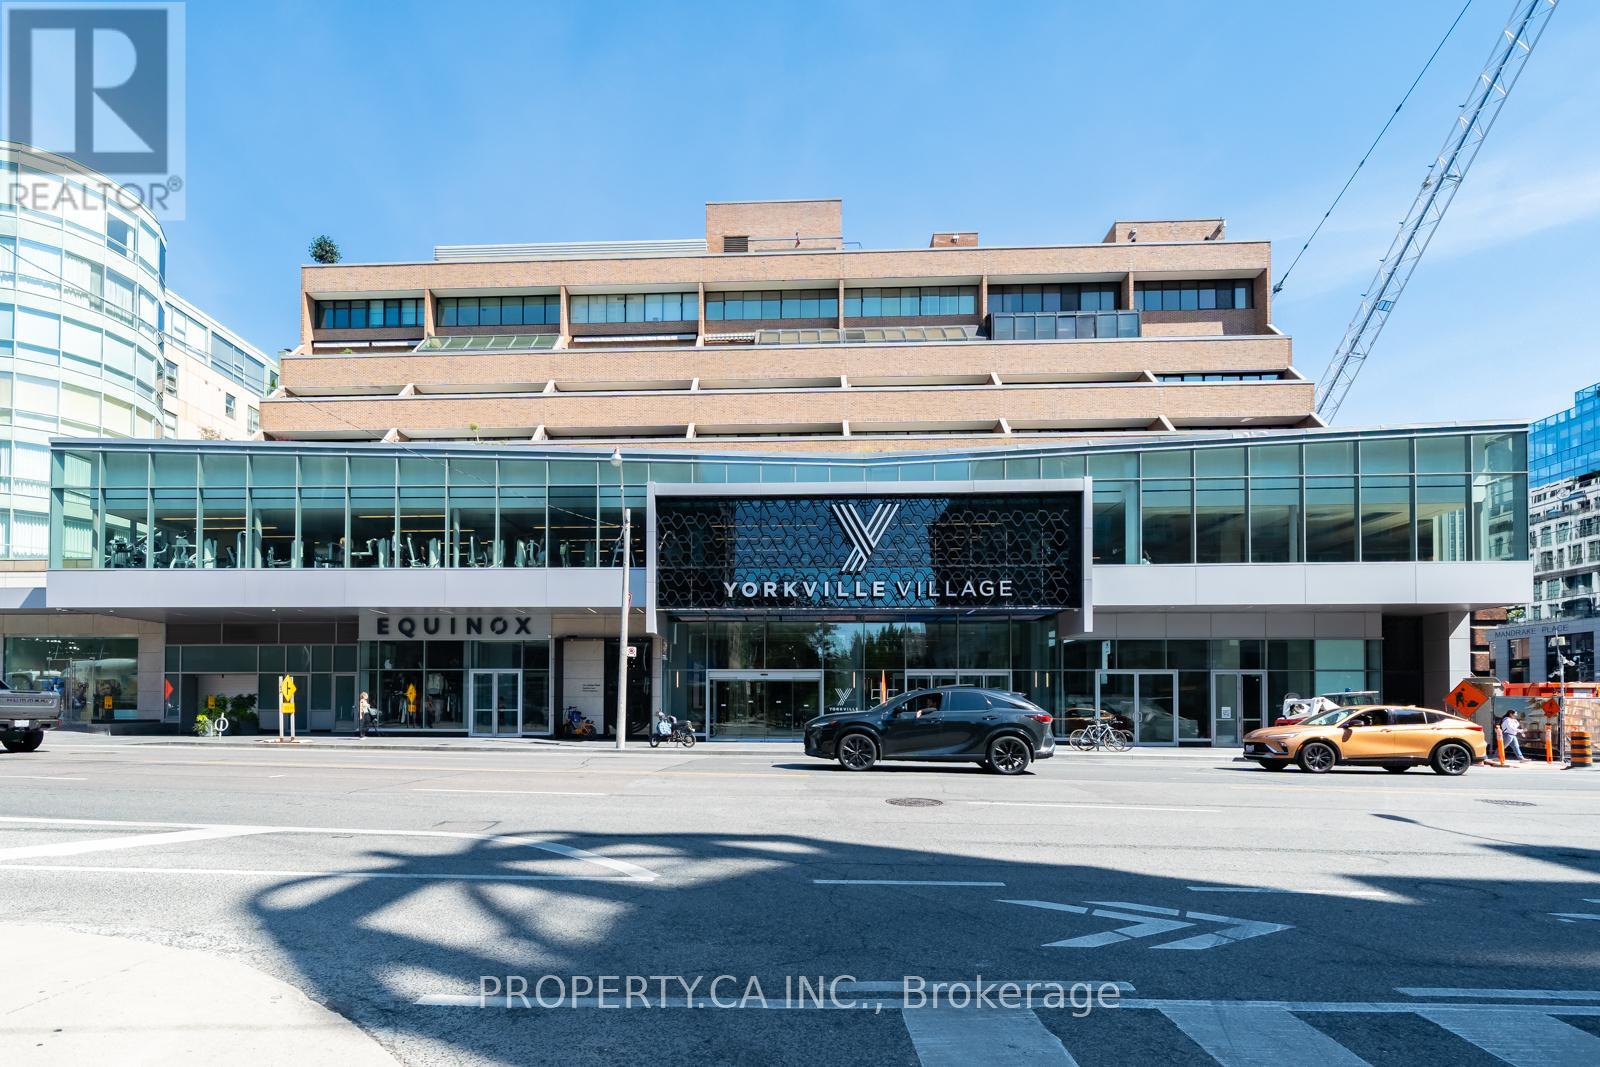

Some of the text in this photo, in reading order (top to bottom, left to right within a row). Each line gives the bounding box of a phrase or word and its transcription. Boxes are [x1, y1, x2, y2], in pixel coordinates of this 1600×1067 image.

[724, 579, 1013, 598] YORKVILLE VILLAGE
[376, 616, 532, 639] EQUINOX
[1494, 624, 1569, 638] MANDRAKE PLACE
